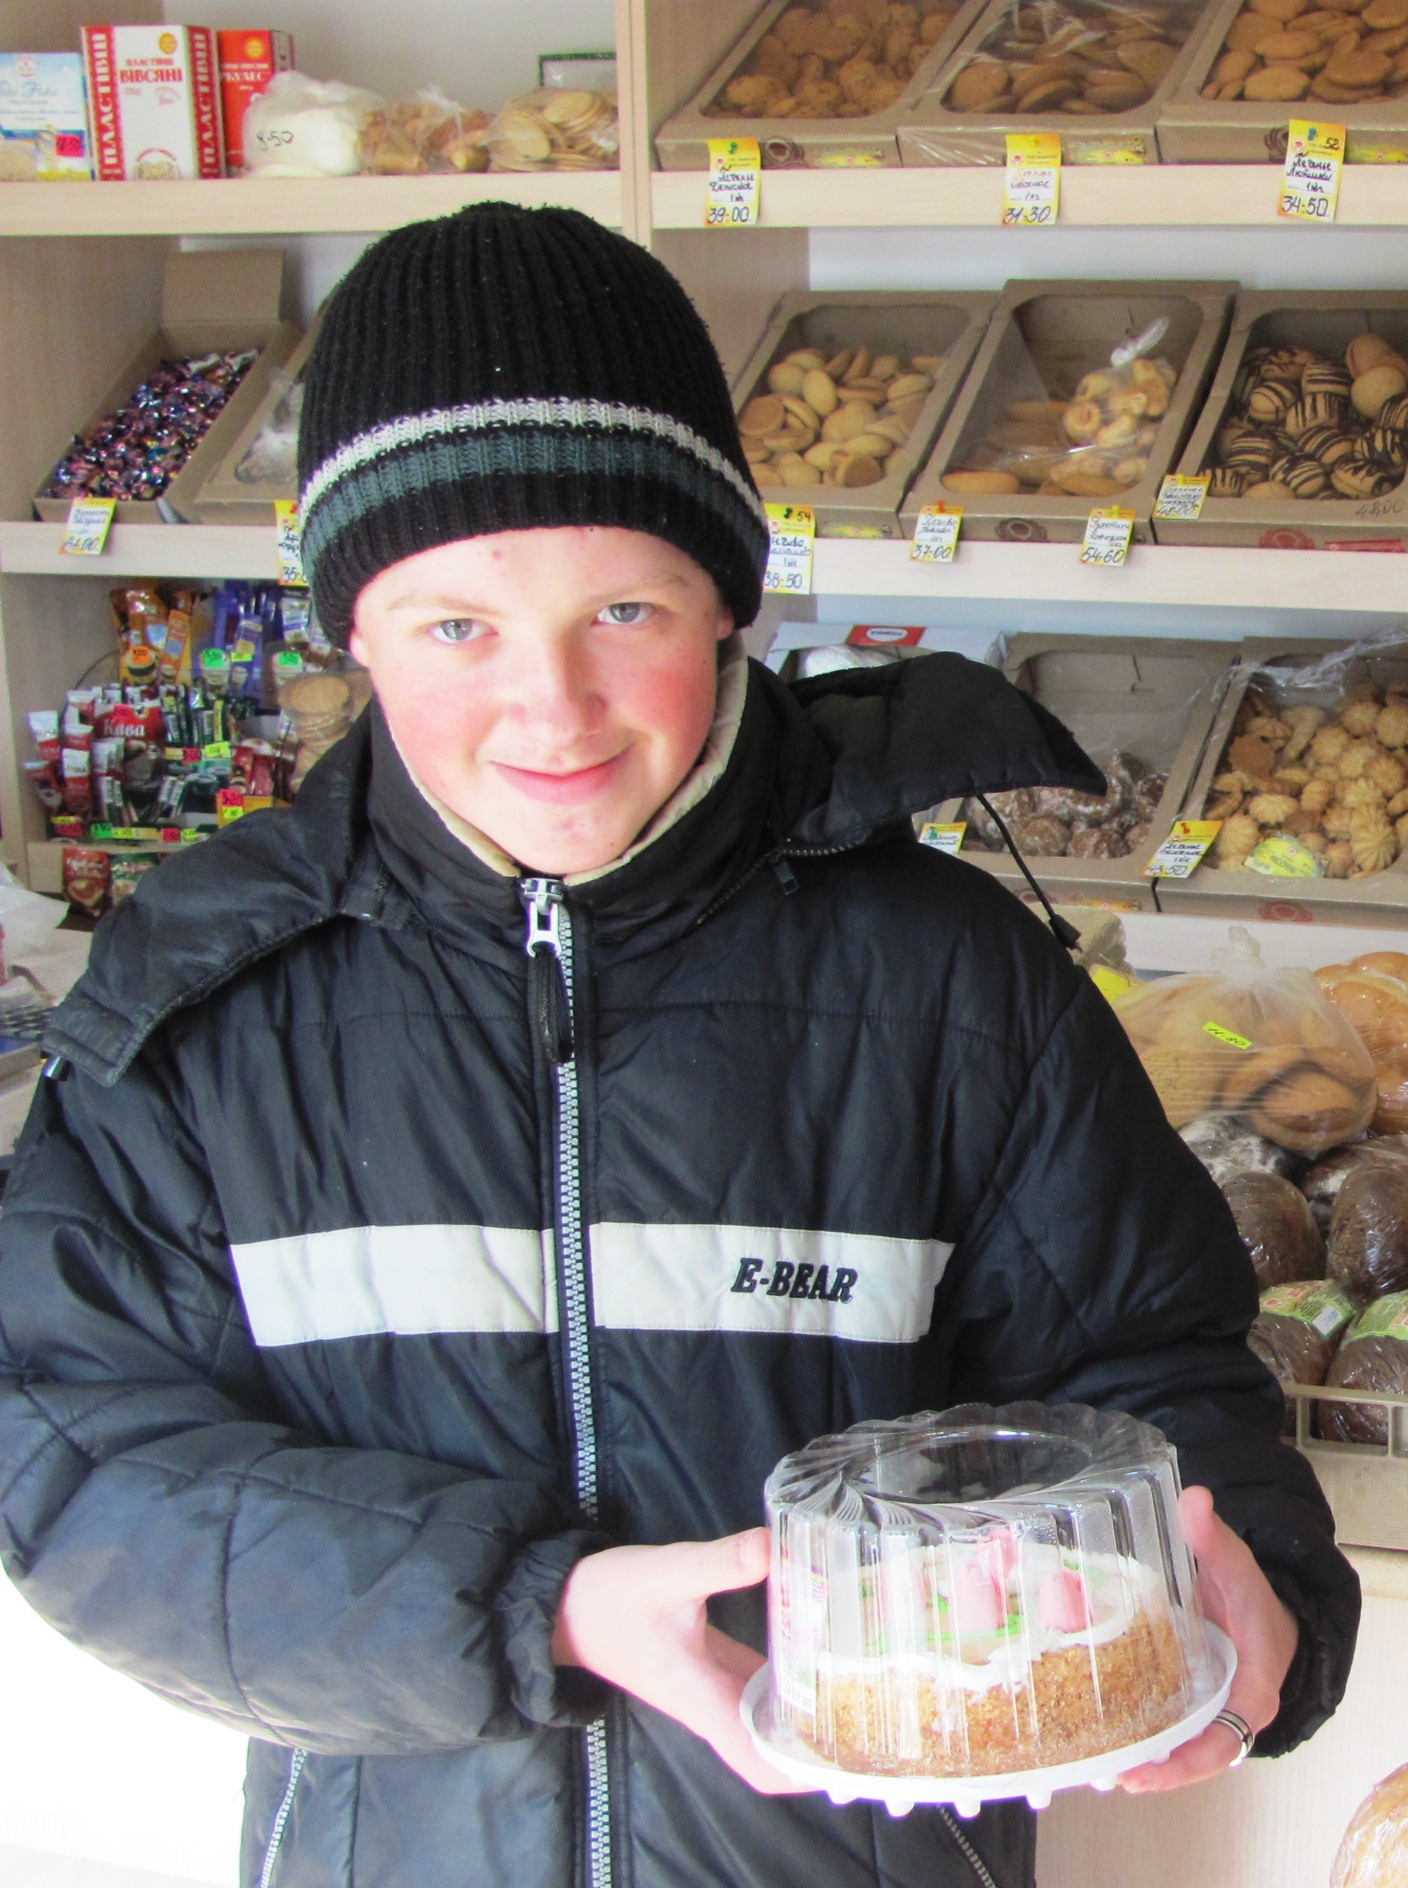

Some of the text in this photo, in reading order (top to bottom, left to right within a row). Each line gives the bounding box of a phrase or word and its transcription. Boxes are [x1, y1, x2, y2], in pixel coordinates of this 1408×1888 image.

[120, 68, 183, 83] ВІВСЯНІ
[1281, 195, 1329, 217] 34-50
[103, 718, 145, 737] Кава
[730, 1257, 858, 1304] E-BEAR
